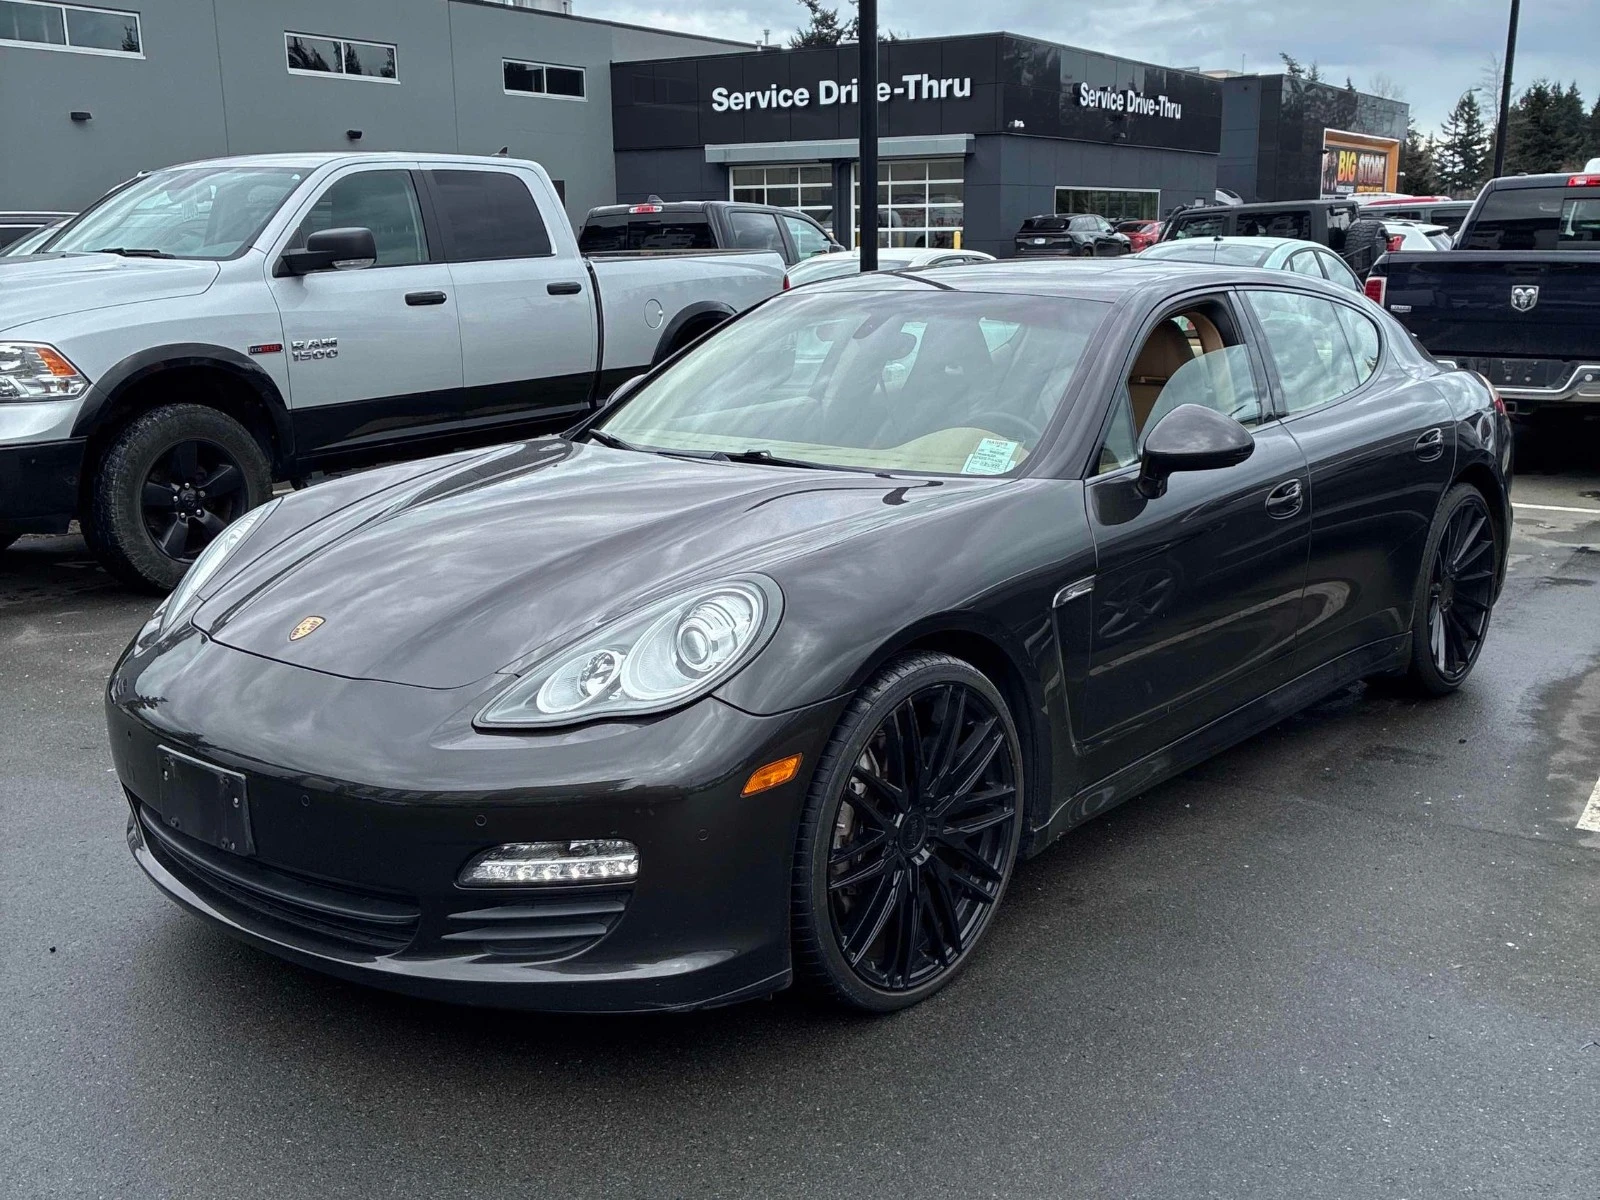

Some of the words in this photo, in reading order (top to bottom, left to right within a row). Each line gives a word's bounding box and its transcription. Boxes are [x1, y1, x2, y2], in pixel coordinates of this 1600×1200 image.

[712, 84, 810, 112] Service
[818, 74, 971, 105] Drie-Thru
[1080, 82, 1124, 112] Service
[1127, 90, 1182, 119] Drive-Thru
[1337, 150, 1357, 182] BIG
[291, 338, 338, 351] RAM
[292, 349, 338, 361] 1500
